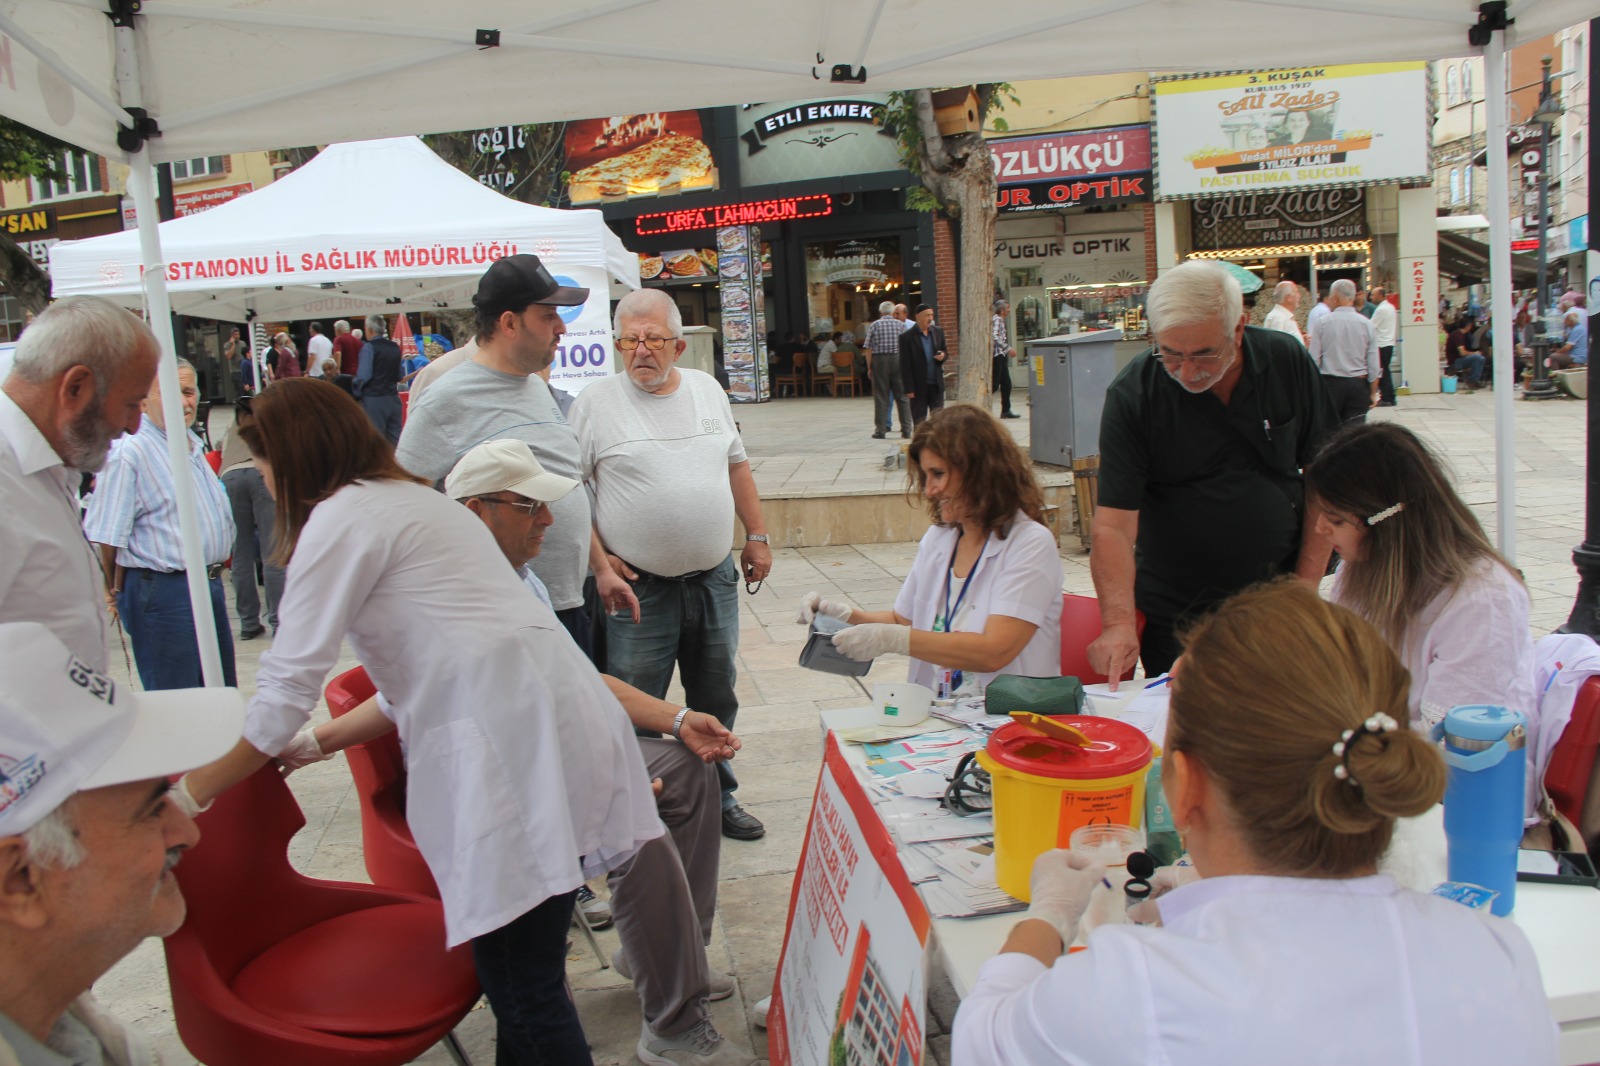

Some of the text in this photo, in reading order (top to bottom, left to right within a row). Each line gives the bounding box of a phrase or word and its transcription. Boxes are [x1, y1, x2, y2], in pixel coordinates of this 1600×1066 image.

[1267, 69, 1326, 82] KUŞAK
[1290, 81, 1312, 90] 1937
[764, 104, 874, 132] ETLİ EKMEK
[990, 135, 1124, 176] ÖZLÜKÇÜ
[1240, 151, 1270, 163] Vedat
[1266, 157, 1296, 170] YILDIZ
[1299, 154, 1331, 167] ALAN
[1200, 165, 1363, 188] PASTIRMA SUCUK
[996, 177, 1145, 207] UR OPTİK
[666, 201, 797, 229] URFA LAHMACUN
[1263, 224, 1363, 242] PASTIRMA SUCUK
[1008, 238, 1131, 259] UĞUR OPTİK
[139, 256, 269, 281] STAMONU
[276, 251, 295, 273] İL
[301, 247, 378, 272] SAĞLIK
[1412, 261, 1426, 322] PASTIRMA
[557, 343, 605, 368] 100
